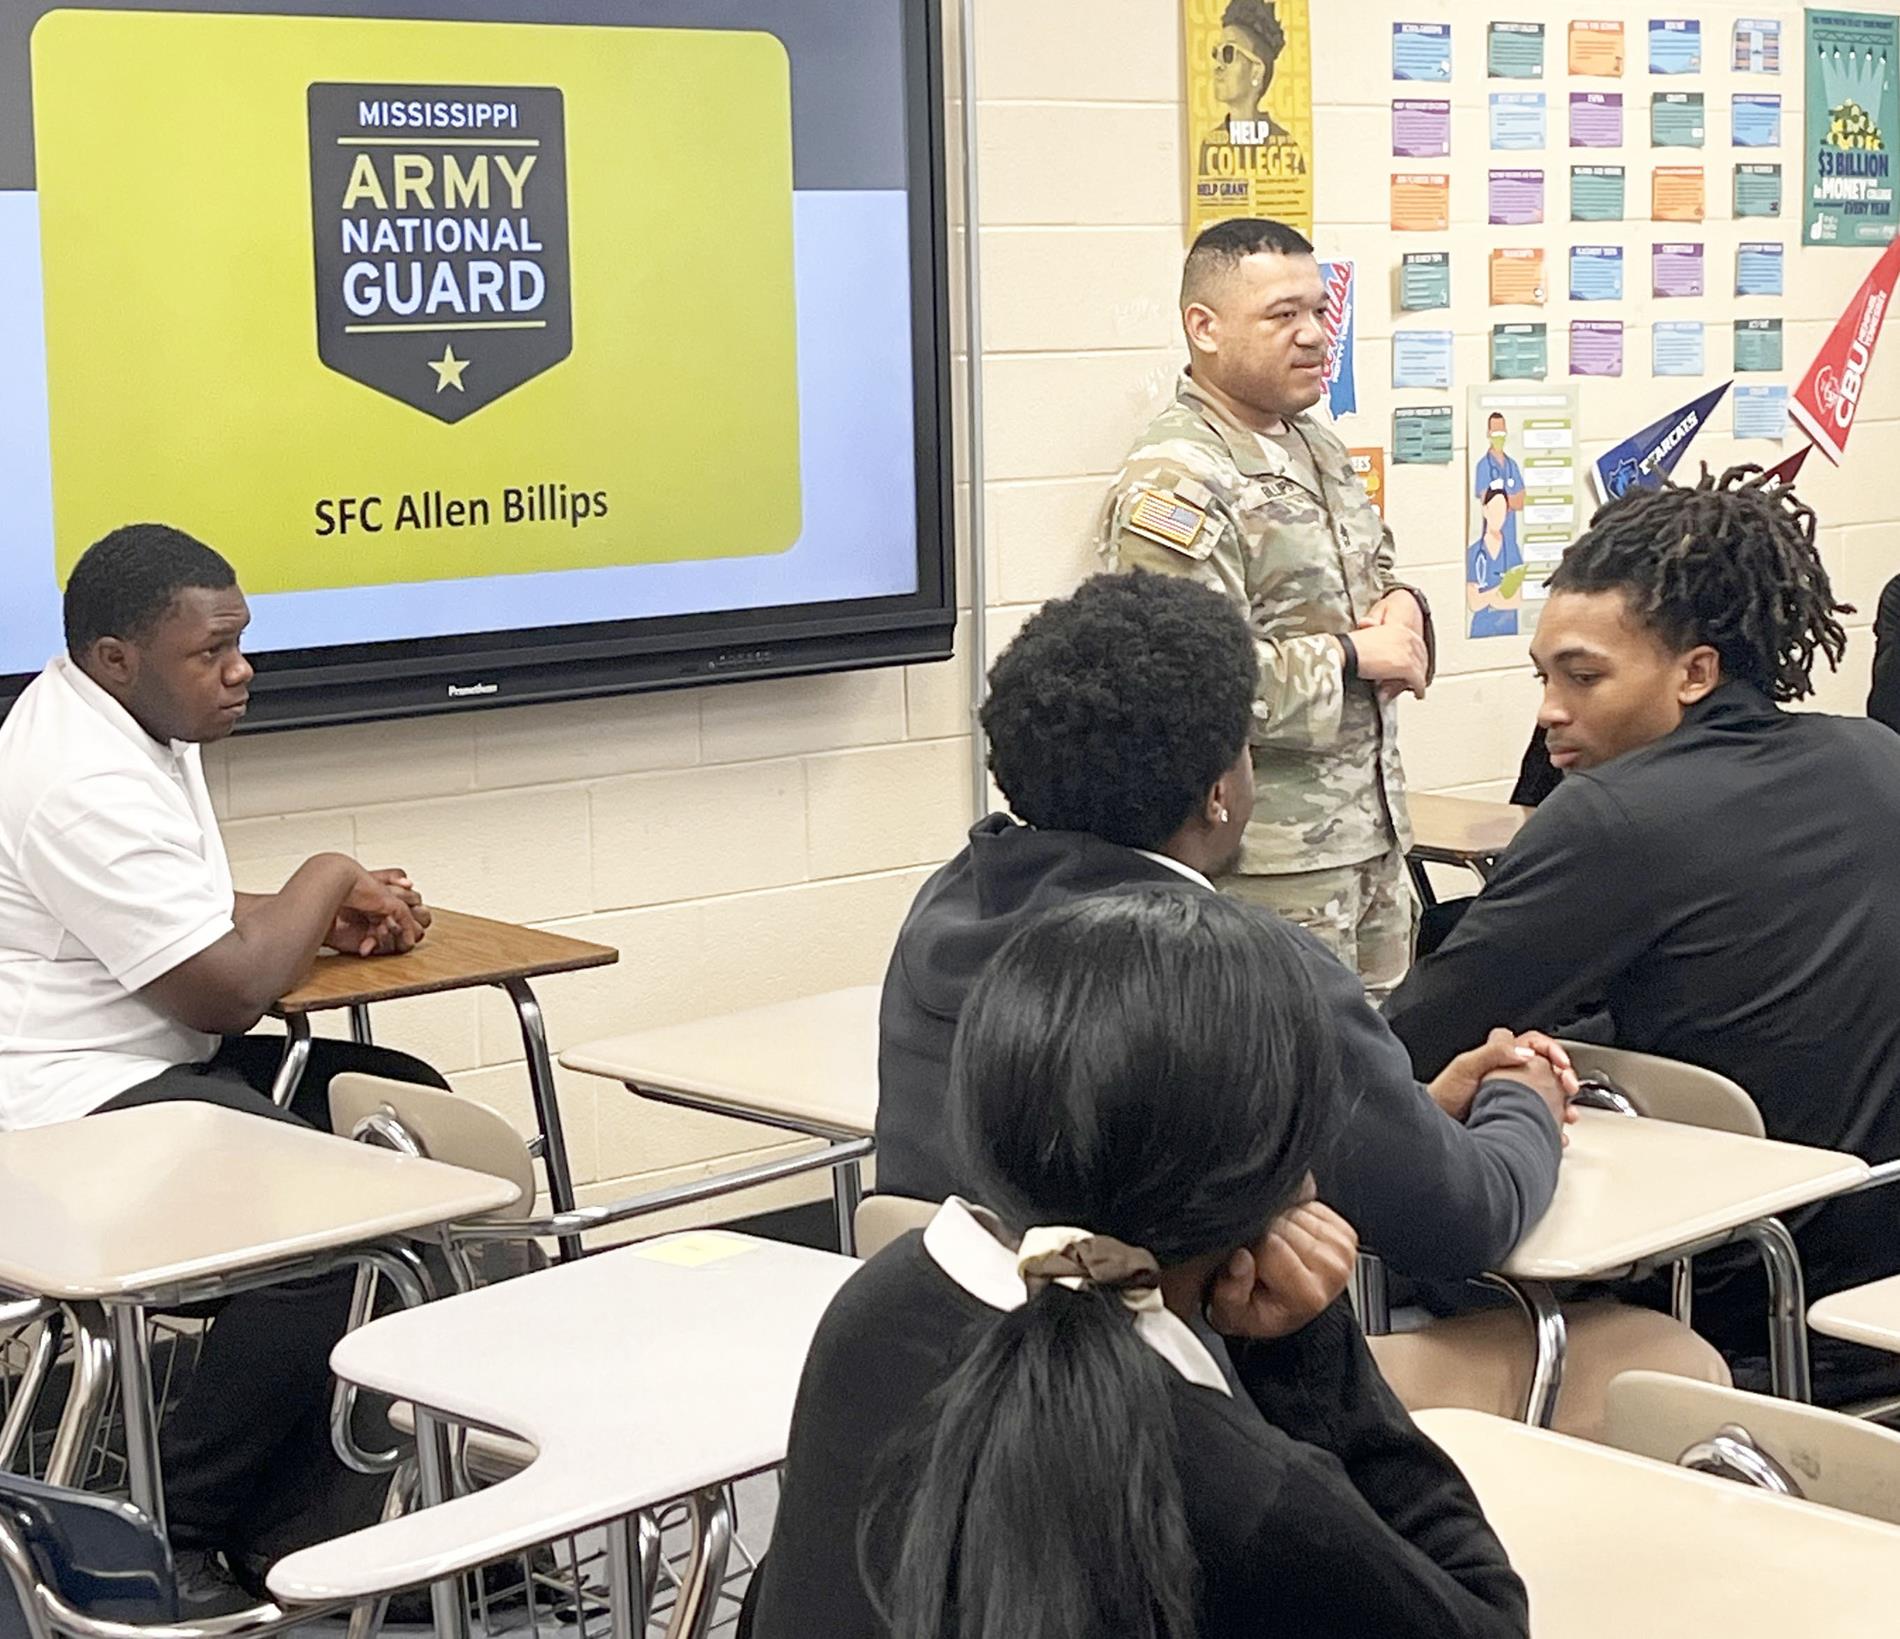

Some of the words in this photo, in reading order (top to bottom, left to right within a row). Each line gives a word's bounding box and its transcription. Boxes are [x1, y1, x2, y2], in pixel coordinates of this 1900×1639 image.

[359, 101, 518, 127] MISSISSIPPI
[1229, 120, 1269, 145] HELP
[1205, 145, 1301, 176] COLLEGE?
[1818, 148, 1834, 177] $3
[1836, 152, 1889, 177] BILLION
[342, 153, 537, 210] ARMY
[1822, 177, 1867, 200] MONEY
[342, 218, 542, 254] NATIONAL
[342, 260, 546, 317] GUARD
[1834, 339, 1869, 428] CBU
[315, 497, 384, 537] SFC
[394, 491, 489, 531] Allen
[503, 484, 608, 528] Billips
